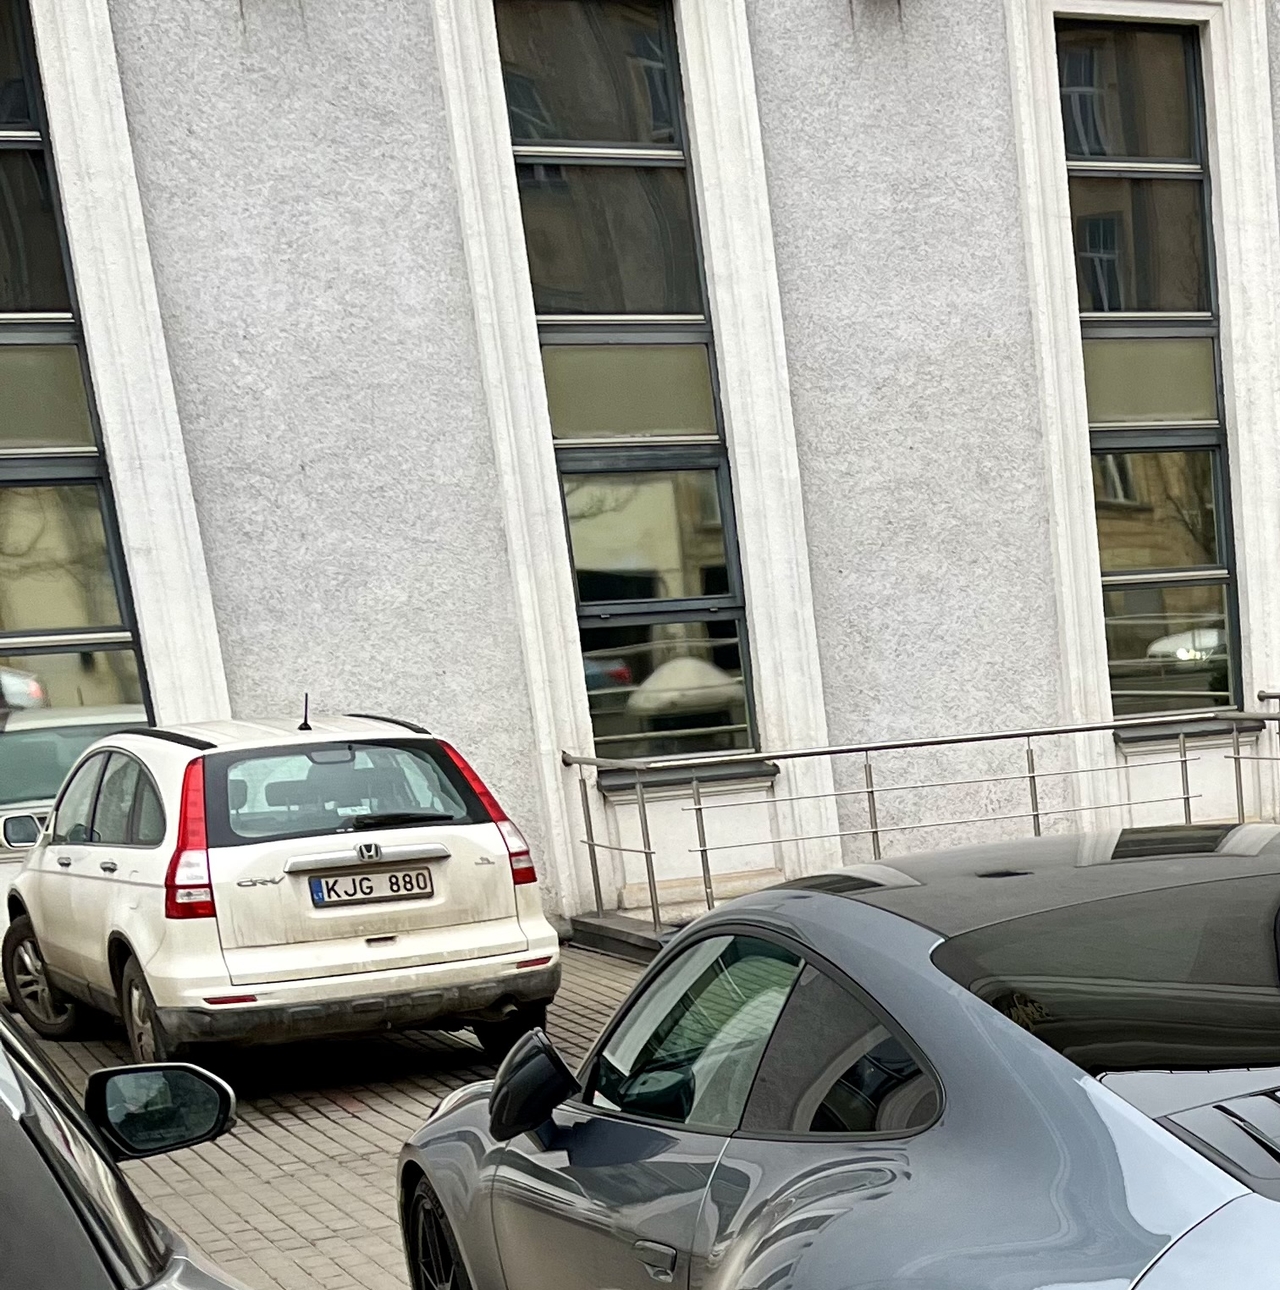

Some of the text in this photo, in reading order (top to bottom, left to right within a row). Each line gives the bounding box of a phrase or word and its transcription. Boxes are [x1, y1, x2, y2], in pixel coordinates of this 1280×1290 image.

[325, 872, 428, 899] KJG 880
[313, 892, 323, 900] LT
